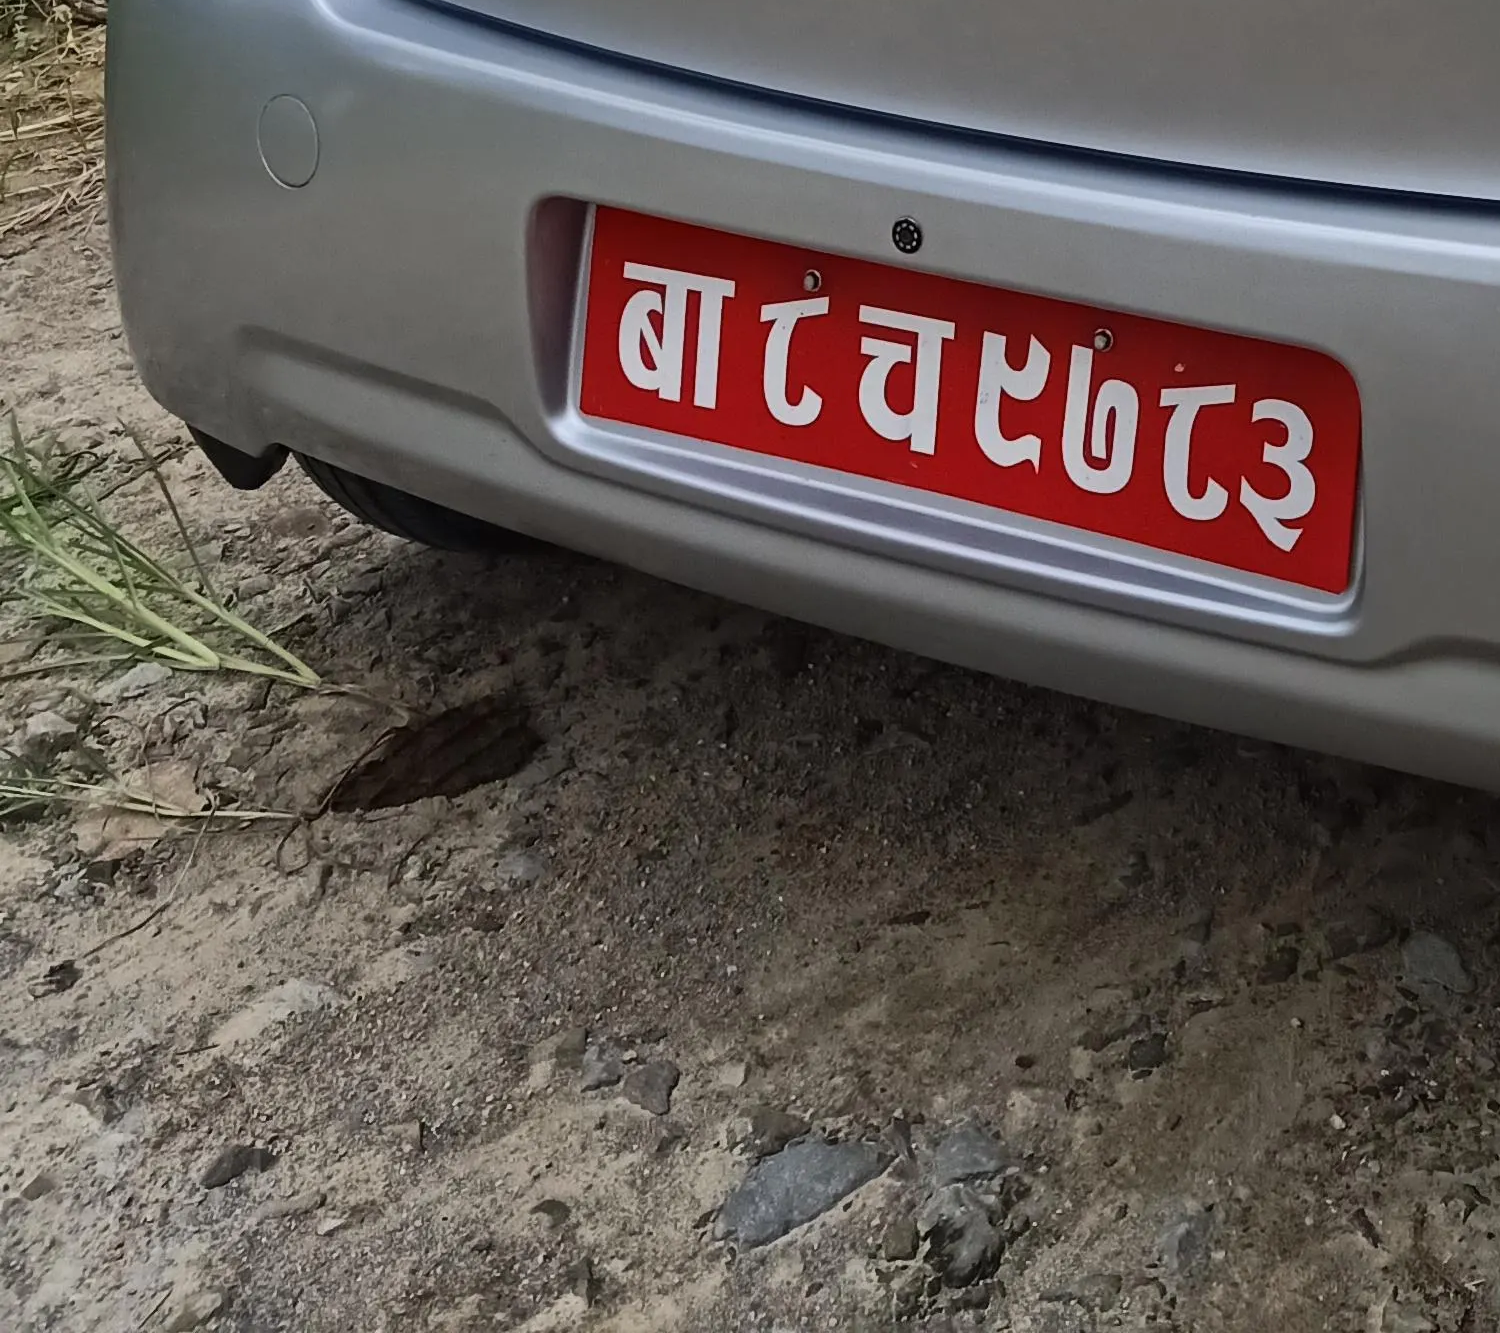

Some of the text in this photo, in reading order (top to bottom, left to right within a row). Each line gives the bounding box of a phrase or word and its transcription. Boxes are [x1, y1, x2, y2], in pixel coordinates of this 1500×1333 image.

[618, 261, 735, 410] बा
[760, 296, 829, 426] ८
[858, 304, 956, 456] च
